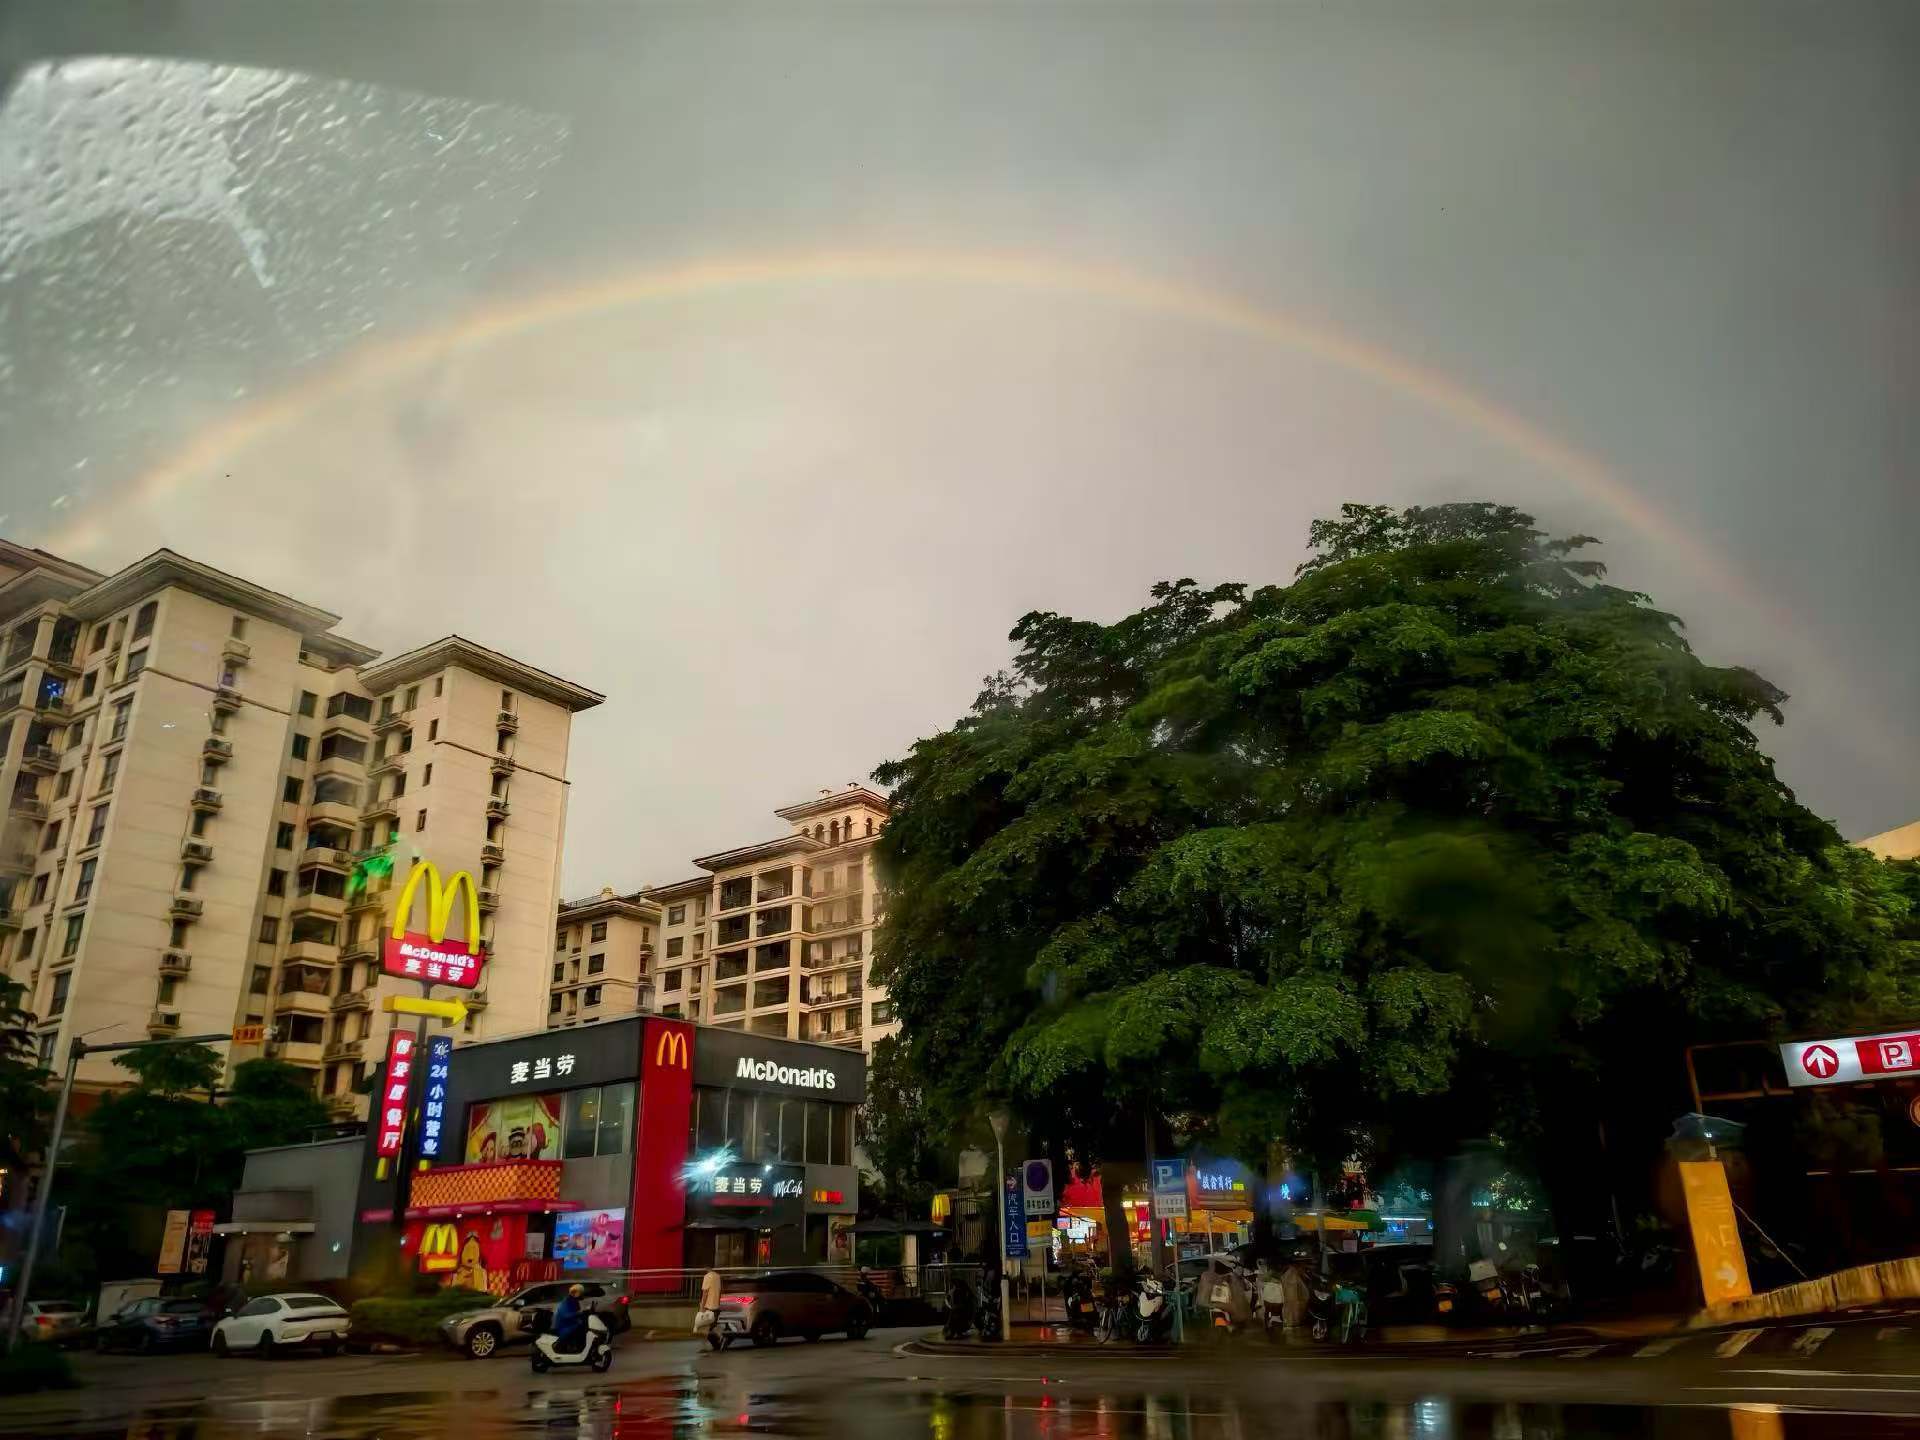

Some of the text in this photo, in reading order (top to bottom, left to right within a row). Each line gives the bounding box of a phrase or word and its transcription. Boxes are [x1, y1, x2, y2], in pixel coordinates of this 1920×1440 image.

[400, 943, 475, 968] McDonald's
[405, 958, 464, 982] 麦当劳
[510, 1053, 576, 1084] 麦当劳
[736, 1057, 837, 1090] McDonald's
[714, 1176, 763, 1194] 麦当劳
[1157, 1165, 1173, 1187] P
